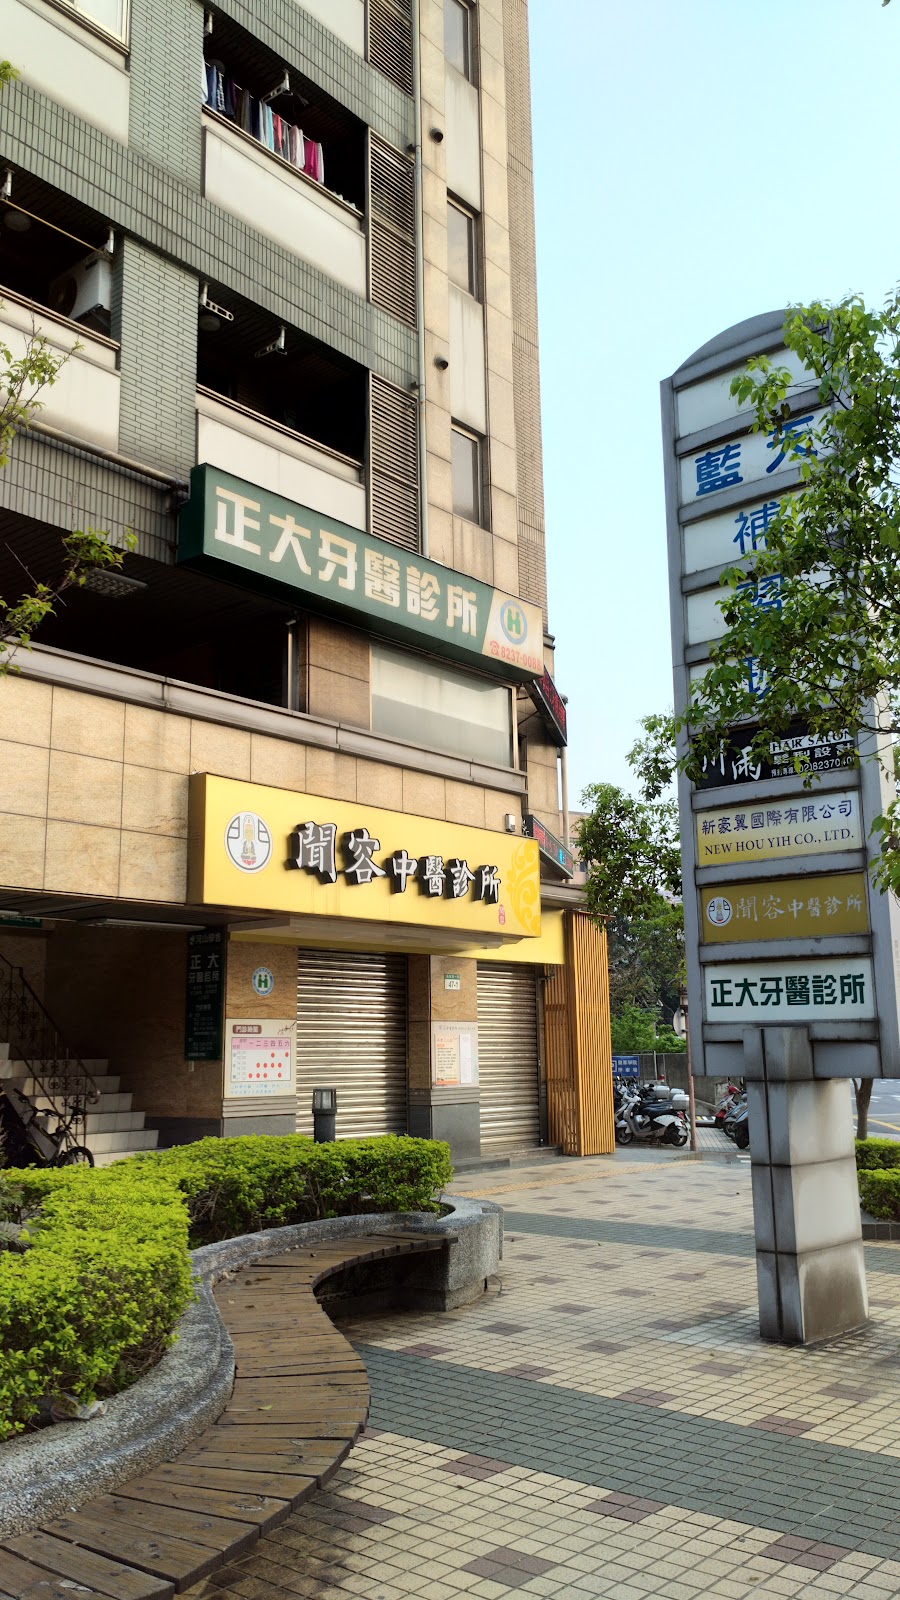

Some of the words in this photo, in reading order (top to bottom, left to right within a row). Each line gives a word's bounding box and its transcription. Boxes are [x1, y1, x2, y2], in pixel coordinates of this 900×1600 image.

[213, 485, 479, 637] 正大牙醫診所
[501, 646, 542, 671] 8237-0088
[772, 738, 803, 752] HAIR
[701, 799, 853, 836] 新豪翼國際有限公司
[704, 842, 733, 856] NEW
[735, 838, 765, 852] HOU
[767, 834, 792, 848] YIH
[794, 831, 822, 846] CO.,
[824, 828, 855, 842] LTD.
[291, 821, 502, 904] 聞容中醫診所
[736, 894, 863, 922] 聞容中醫診所
[190, 952, 220, 970] 正大
[710, 973, 865, 1007] 正大牙醫診所
